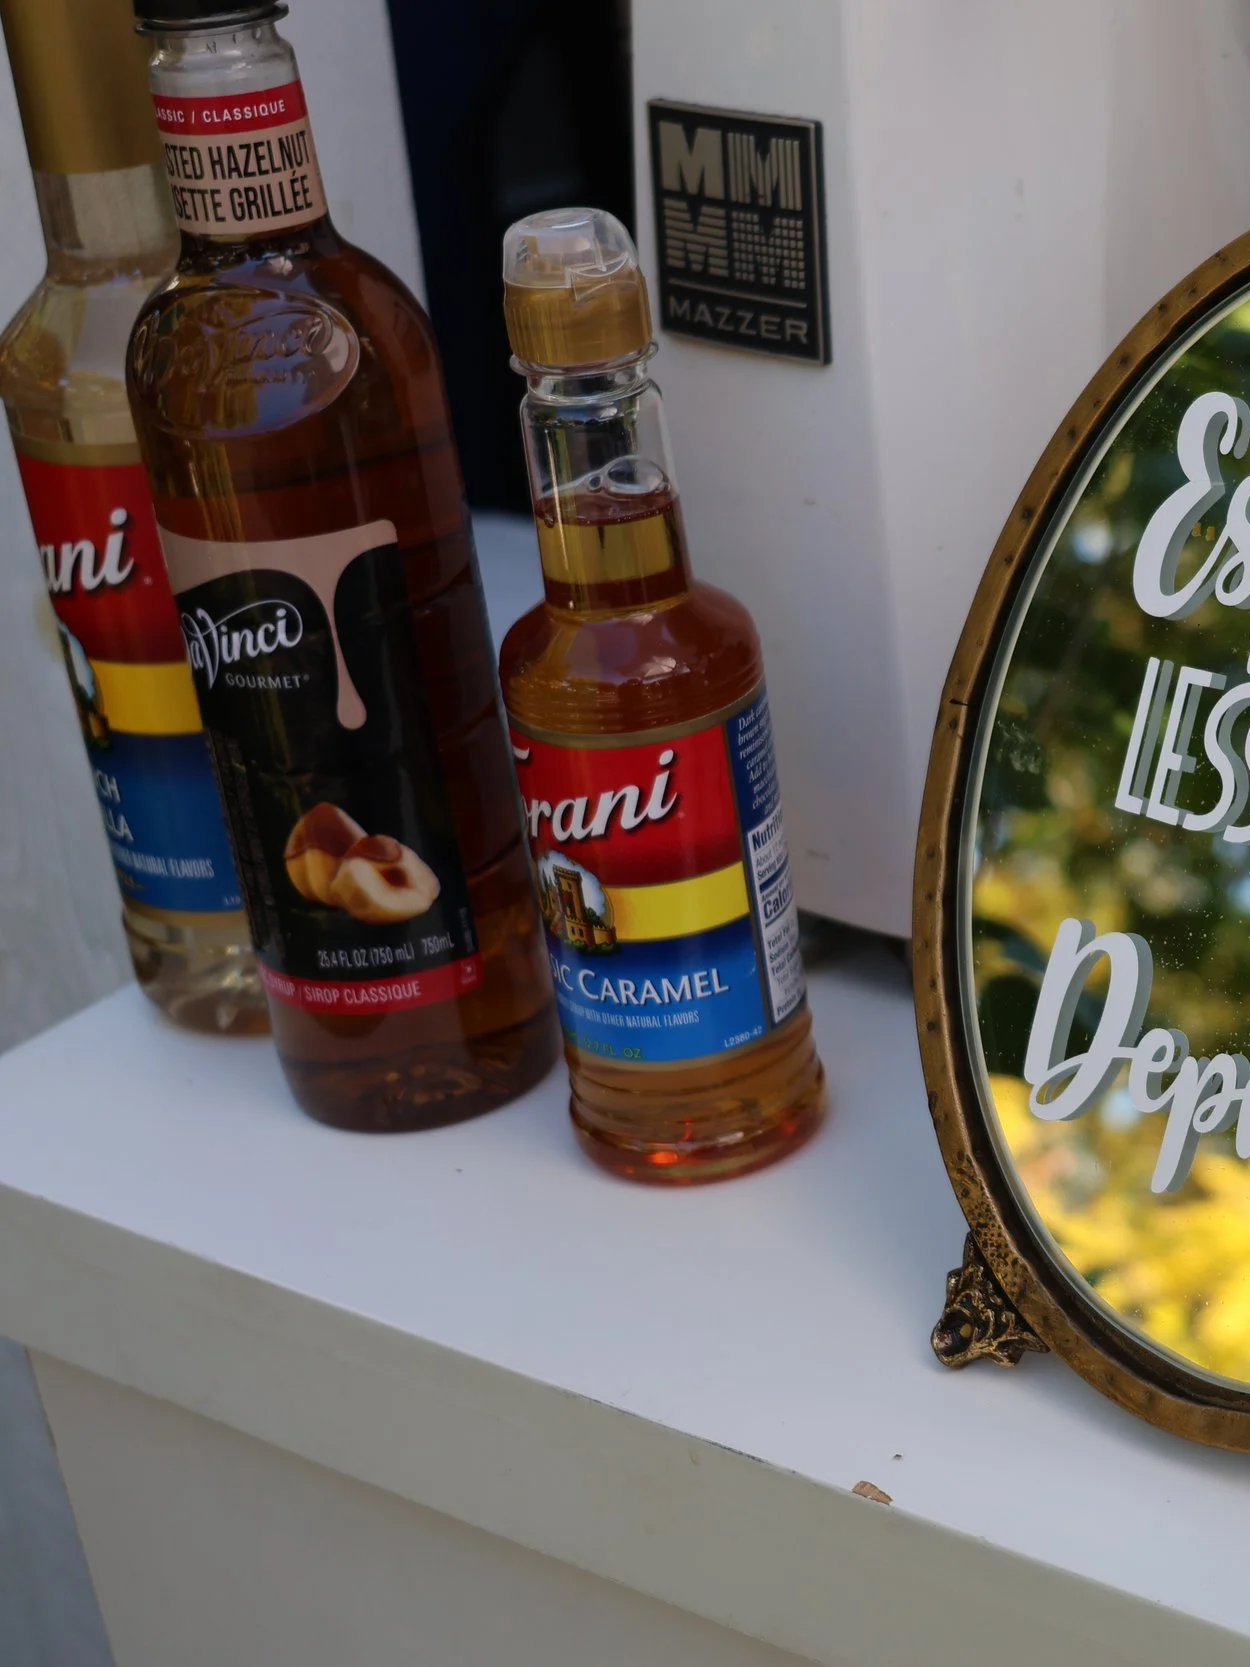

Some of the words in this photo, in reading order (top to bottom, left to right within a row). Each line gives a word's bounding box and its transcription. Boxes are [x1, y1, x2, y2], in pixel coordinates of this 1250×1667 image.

[203, 99, 286, 123] CLASSIQUE
[208, 130, 310, 180] HAZELNUT
[229, 170, 313, 222] GRILLÉE
[668, 295, 808, 345] MAZZER
[225, 672, 301, 689] GOURMET
[513, 749, 678, 842] rani
[170, 858, 215, 878] FLAVORS
[421, 931, 455, 956] 750mL
[339, 950, 352, 968] FL
[354, 949, 369, 967] OZ
[304, 985, 340, 1004] SIROP
[343, 980, 422, 1005] CLASSIQUE
[577, 967, 731, 1007] CARAMEL
[625, 1015, 662, 1029] NATURAL
[663, 1010, 700, 1027] FLAVORS
